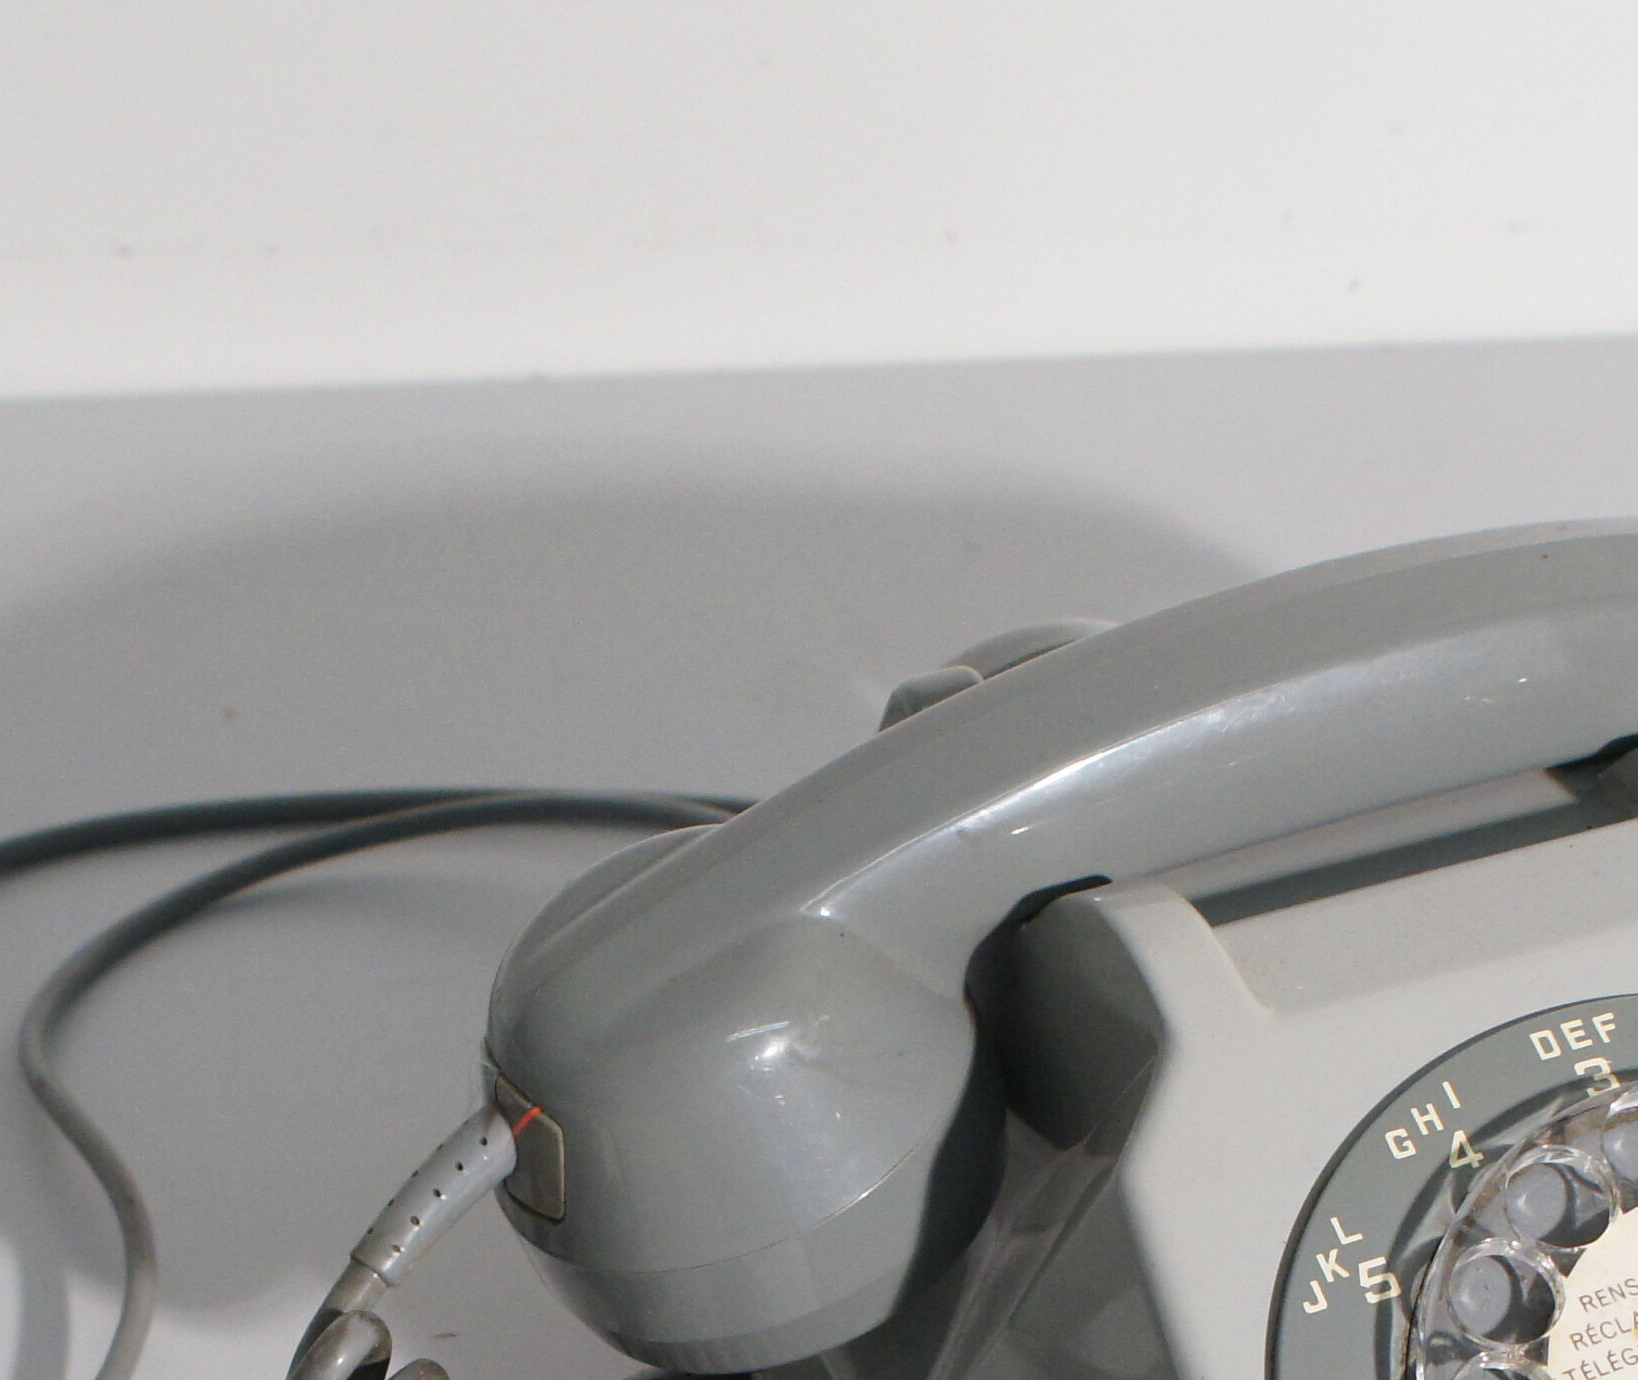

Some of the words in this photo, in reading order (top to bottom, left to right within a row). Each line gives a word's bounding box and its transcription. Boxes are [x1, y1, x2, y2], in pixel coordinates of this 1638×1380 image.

[1574, 1057, 1621, 1098] 3
[1449, 1130, 1484, 1168] 4
[1358, 1256, 1402, 1304] 5
